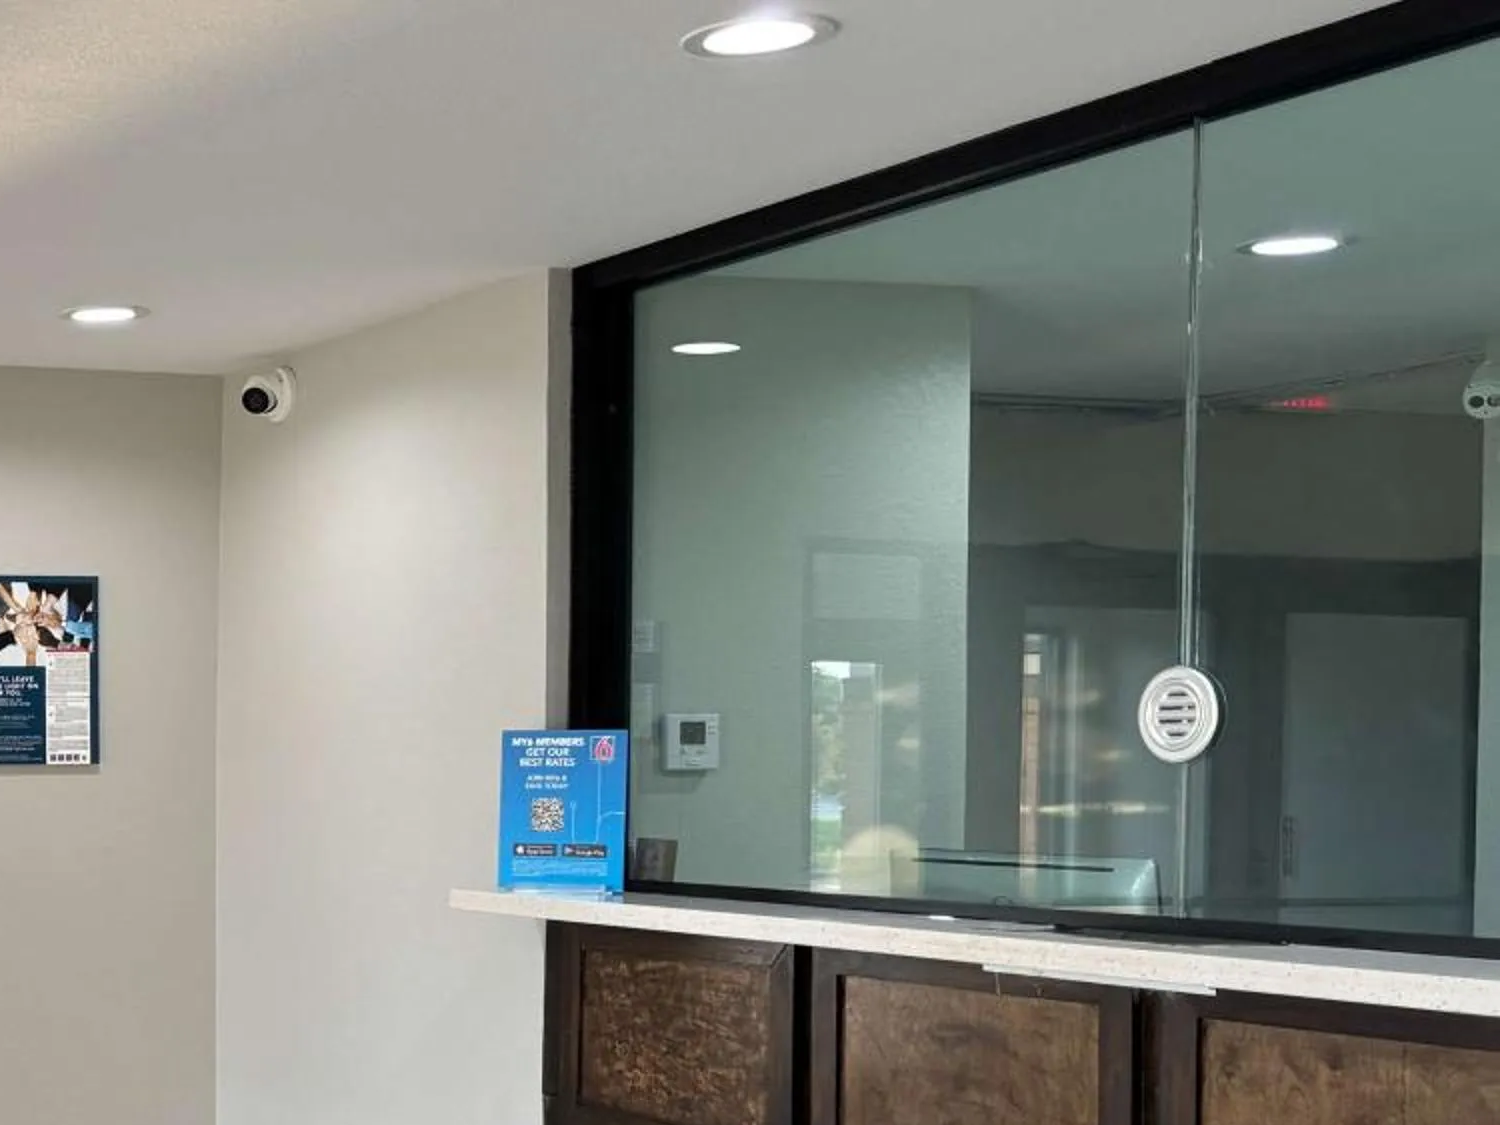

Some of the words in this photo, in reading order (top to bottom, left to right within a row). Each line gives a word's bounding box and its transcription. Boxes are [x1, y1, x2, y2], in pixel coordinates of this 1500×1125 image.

[535, 737, 585, 747] MEMBERS
[525, 748, 545, 757] GET
[547, 748, 570, 757] OUR
[519, 758, 542, 767] BEST
[545, 758, 576, 767] RATES
